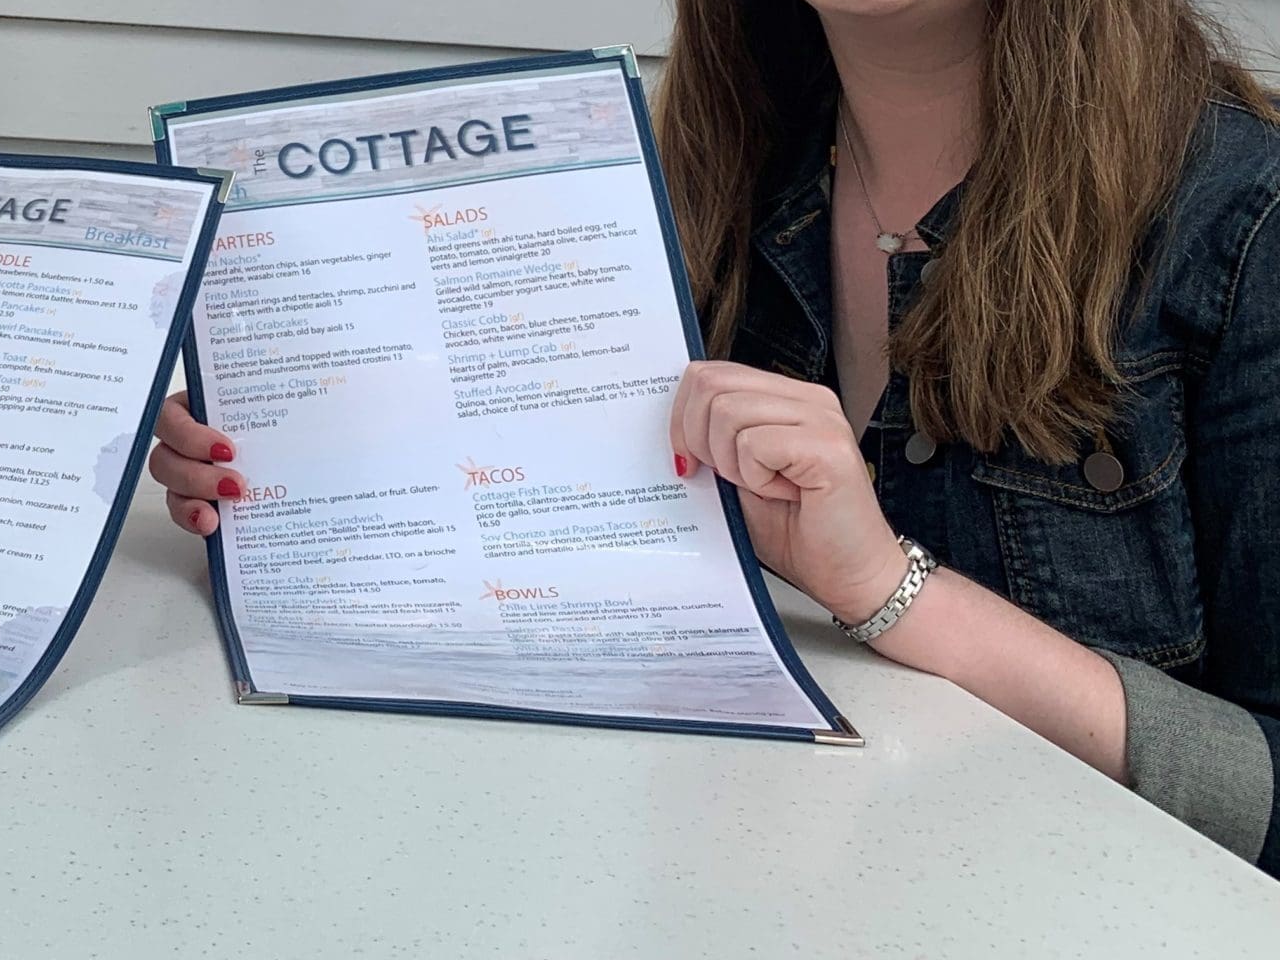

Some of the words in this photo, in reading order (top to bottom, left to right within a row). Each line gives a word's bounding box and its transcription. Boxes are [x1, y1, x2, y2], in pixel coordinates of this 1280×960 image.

[253, 149, 267, 176] The
[278, 114, 536, 179] COTTAGE
[423, 207, 488, 229] SALADS
[84, 225, 170, 250] Breakfast
[212, 232, 275, 251] ARTERS
[434, 272, 473, 285] Salmon
[475, 267, 523, 280] Romaine
[524, 262, 563, 277] Wedge
[435, 284, 462, 295] Grilled
[462, 282, 480, 291] wild
[514, 274, 548, 285] romaine
[578, 268, 599, 279] baby
[26, 282, 73, 294] Pancakes
[205, 290, 228, 301] Frito
[230, 288, 259, 298] Misto
[206, 301, 226, 311] Fried
[227, 298, 260, 308] calamari
[261, 295, 281, 307] rings
[282, 294, 297, 303] and
[367, 283, 399, 294] zucchini
[401, 281, 416, 290] and
[17, 325, 64, 336] Pancakes
[441, 317, 477, 329] Classic
[478, 314, 509, 325] Cobb
[210, 335, 225, 344] Pan
[227, 332, 252, 342] seared
[254, 330, 275, 341] lump
[296, 327, 309, 335] old
[311, 325, 325, 336] bay
[327, 323, 343, 332] aioli
[345, 322, 354, 330] 15
[2, 353, 29, 362] Toast
[213, 349, 244, 360] Baked
[246, 347, 267, 357] Brie
[449, 363, 476, 373] Hearts
[476, 362, 486, 370] of
[581, 344, 630, 357] lemon-basil
[219, 395, 246, 405] Served
[247, 393, 265, 402] with
[266, 391, 284, 402] pico
[285, 390, 295, 398] de
[297, 388, 317, 399] gallo
[319, 387, 327, 395] 11
[454, 386, 493, 399] Stuffed
[494, 380, 542, 394] Avocado
[222, 410, 259, 424] Today's
[261, 407, 289, 421] Soup
[10, 442, 26, 450] and
[468, 467, 525, 486] TACOS
[472, 489, 517, 504] Cottage
[518, 486, 540, 497] Fish
[543, 483, 573, 494] Tacos
[232, 502, 261, 512] Served
[262, 500, 280, 509] with
[281, 497, 307, 507] french
[329, 494, 353, 504] green
[233, 512, 249, 521] free
[251, 510, 275, 520] bread
[276, 507, 311, 517] available
[494, 587, 559, 600] BOWLS
